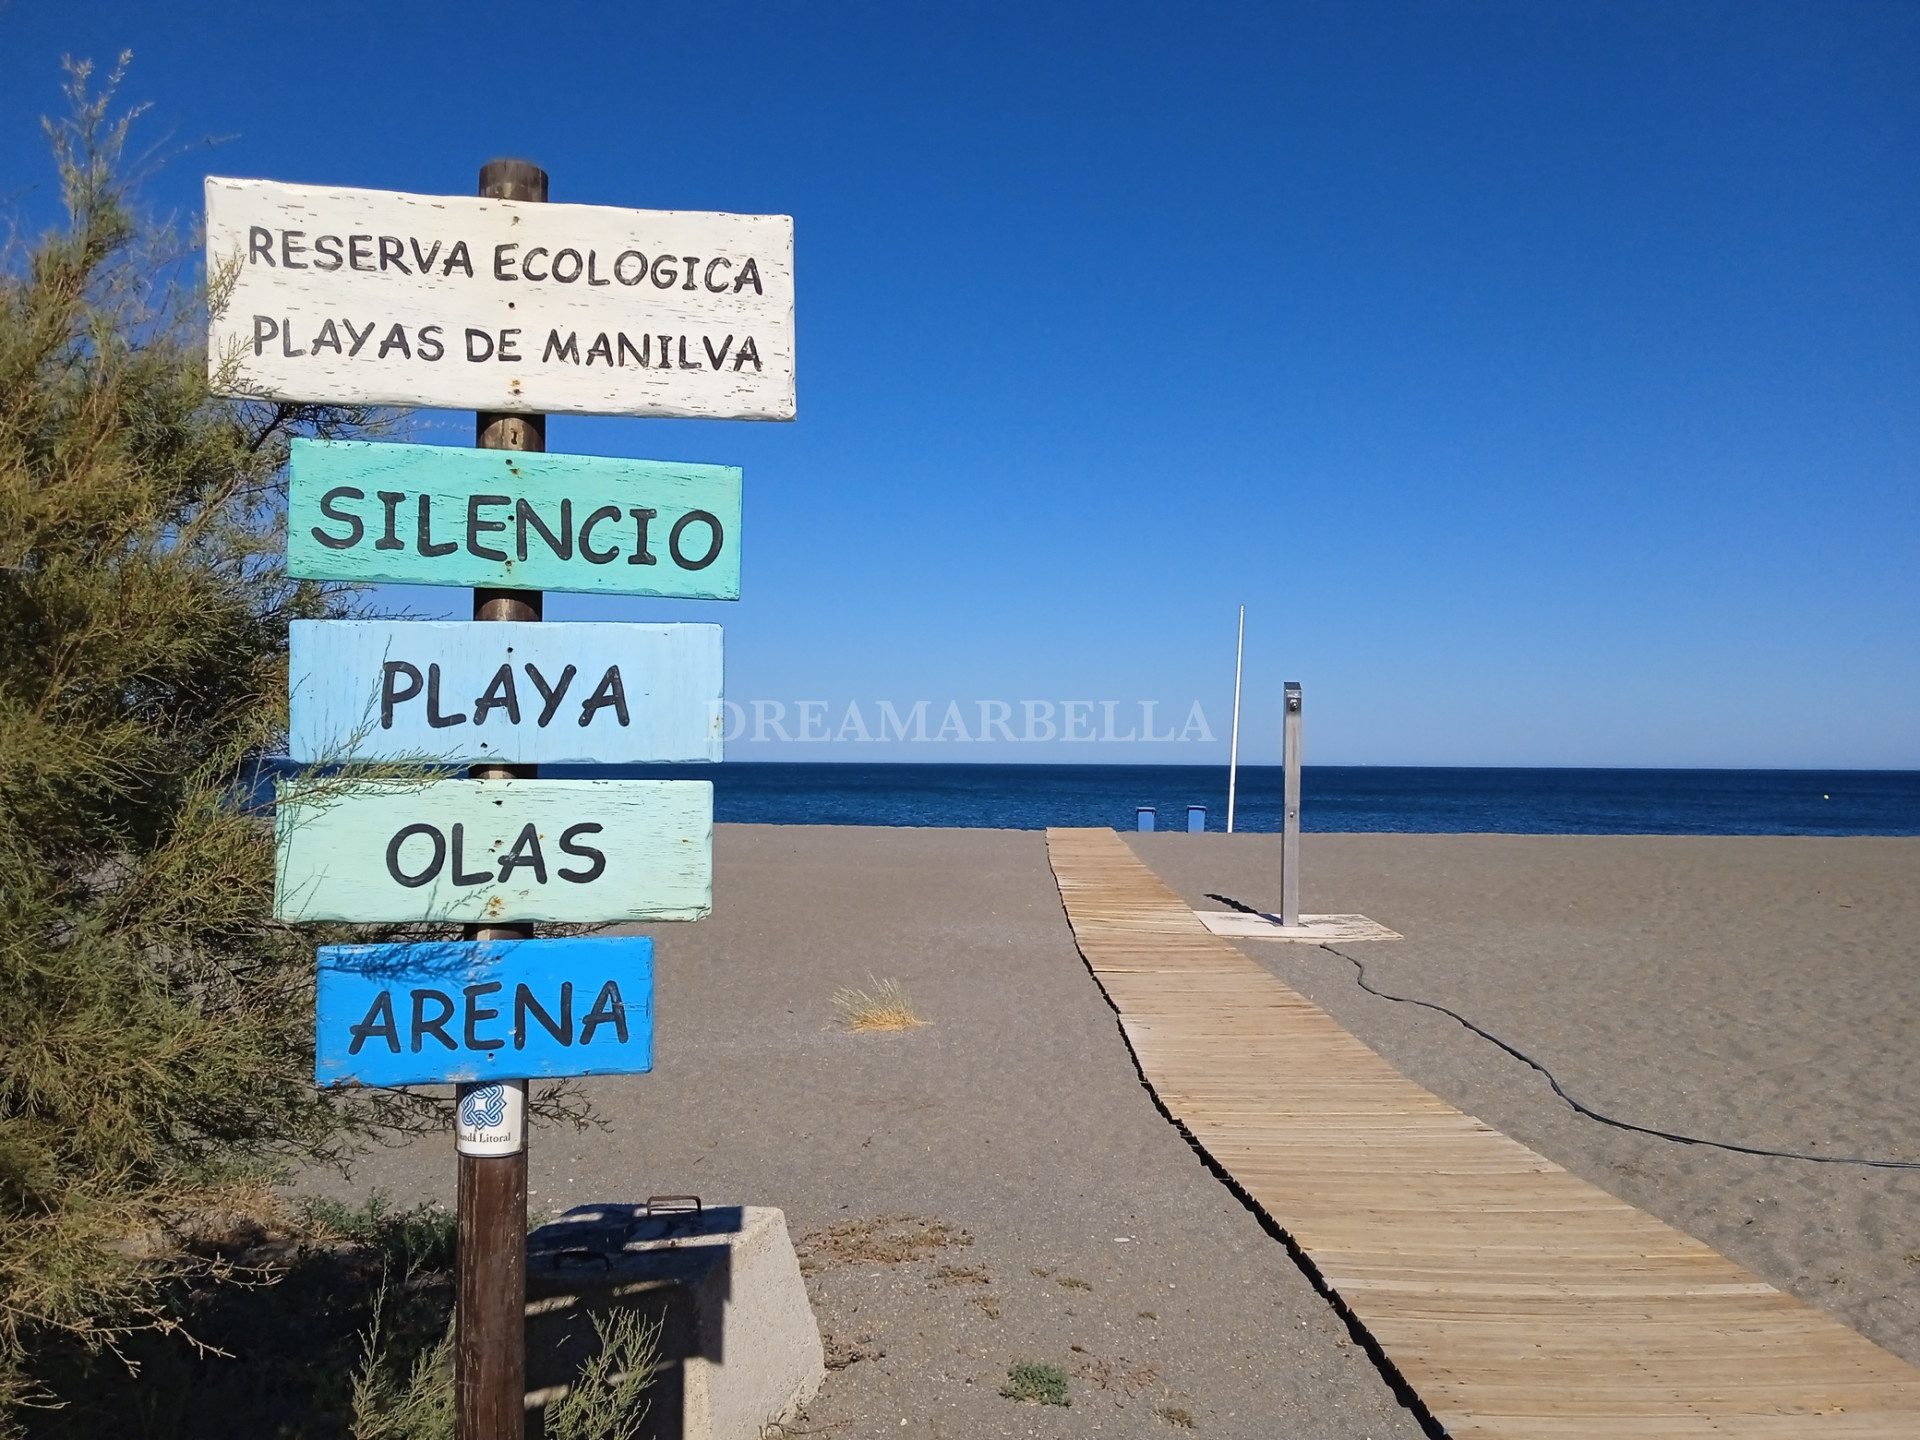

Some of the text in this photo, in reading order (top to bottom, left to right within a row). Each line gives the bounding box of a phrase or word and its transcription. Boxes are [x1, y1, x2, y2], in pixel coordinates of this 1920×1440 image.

[249, 225, 764, 297] RESERVA ECOLOGICA
[253, 315, 762, 372] PLAYAS DE MANILVA
[310, 486, 724, 571] SILENCIO
[380, 660, 630, 730] PLAYA
[385, 822, 607, 888] OLAS
[348, 980, 629, 1056] ARENA
[479, 1131, 512, 1143] Litoral
